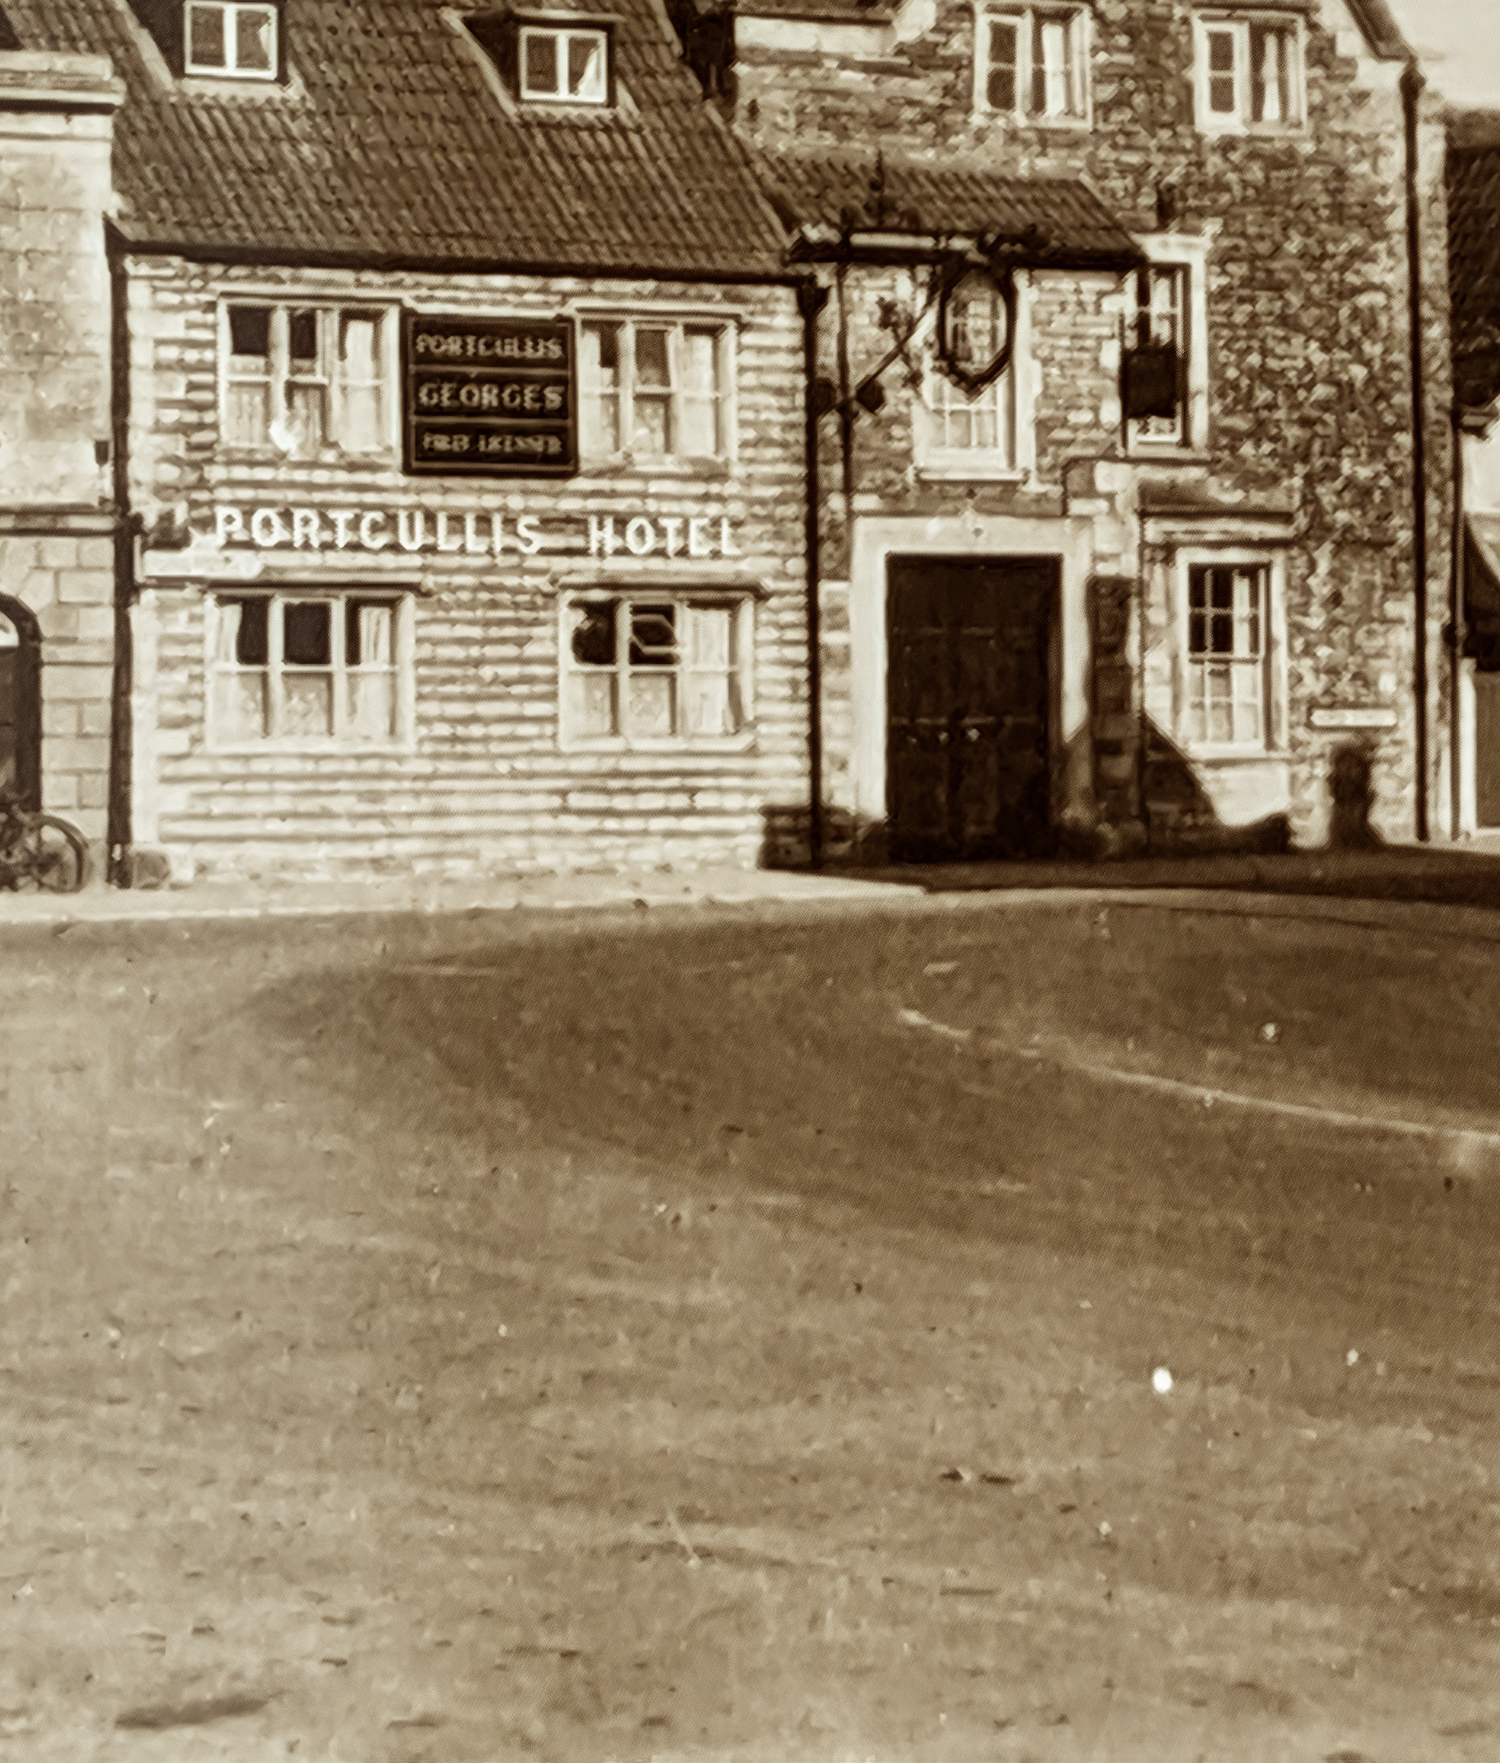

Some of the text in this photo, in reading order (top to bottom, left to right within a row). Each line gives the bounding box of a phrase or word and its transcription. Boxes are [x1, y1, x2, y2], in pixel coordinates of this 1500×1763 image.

[418, 381, 566, 411] GEORGES
[215, 505, 742, 558] PORTCULLIS HOTEL
